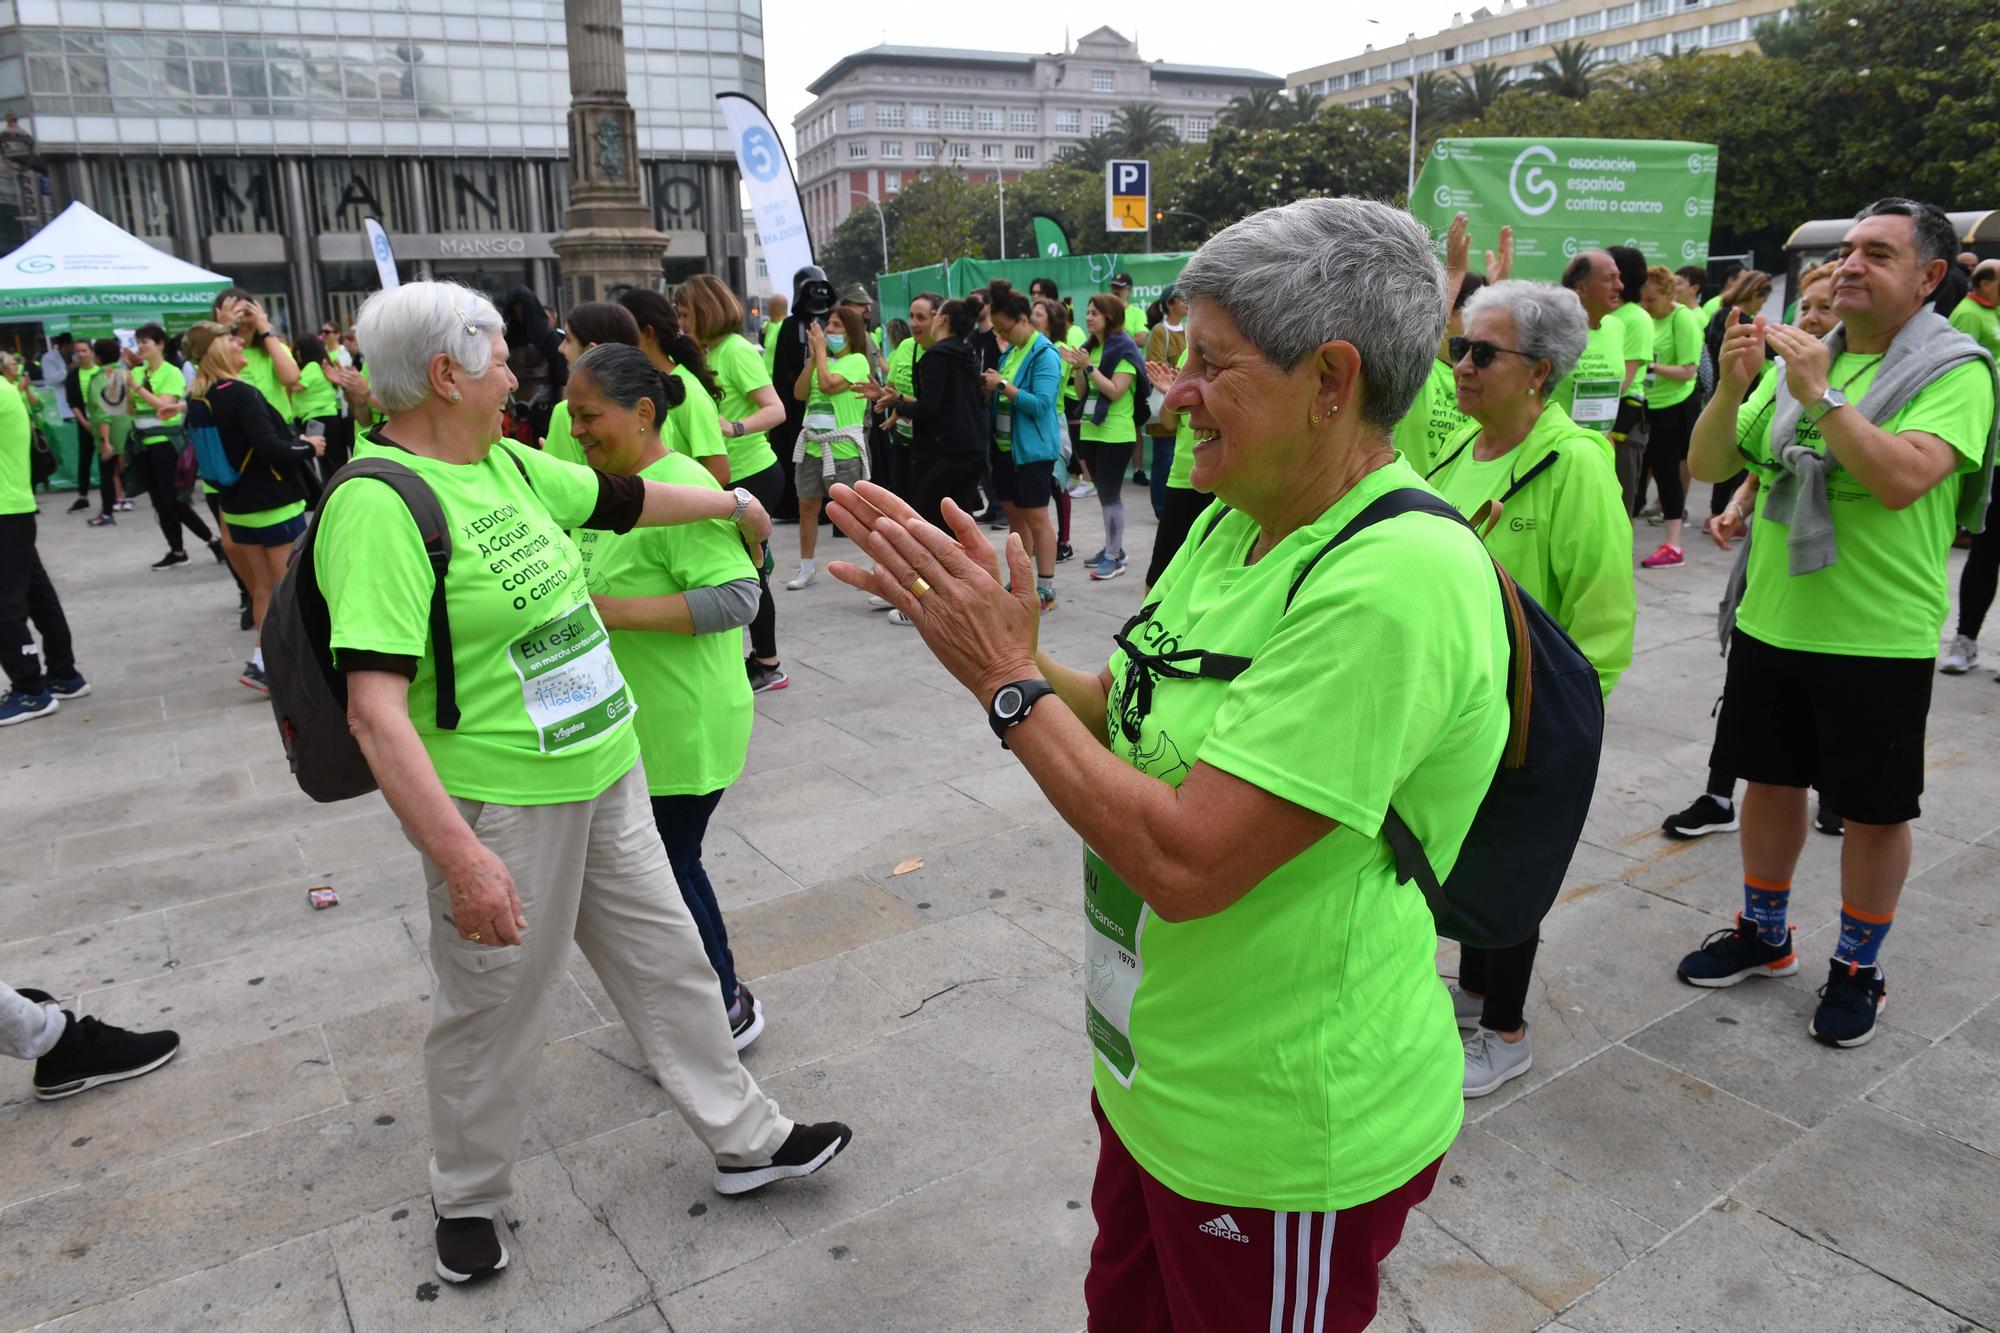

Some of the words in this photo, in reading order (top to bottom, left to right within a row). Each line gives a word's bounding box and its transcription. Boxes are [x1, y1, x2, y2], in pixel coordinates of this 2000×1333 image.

[1568, 155, 1637, 172] asociación
[1120, 165, 1139, 193] P
[1566, 177, 1626, 194] española
[1565, 199, 1608, 212] contra
[1610, 201, 1619, 212] o
[1620, 201, 1664, 214] cancro
[439, 238, 525, 253] MANGO
[27, 293, 99, 307] ESPAÑOLA
[100, 293, 157, 305] CONTRA
[159, 292, 169, 304] O
[171, 292, 216, 304] CANCR
[1432, 409, 1447, 418] en
[461, 526, 475, 539] X
[478, 543, 492, 559] A
[489, 521, 531, 552] Coruñ
[489, 558, 513, 574] en
[502, 559, 549, 592] contra
[512, 596, 527, 610] o
[530, 569, 568, 601] cancro
[520, 640, 548, 660] Eu
[549, 620, 586, 646] estou
[530, 660, 542, 671] en
[542, 648, 571, 666] marcha
[553, 722, 585, 739] Vegalsa
[1095, 909, 1125, 937] cancro
[1118, 951, 1136, 968] 1979
[1199, 1224, 1250, 1243] adidas
